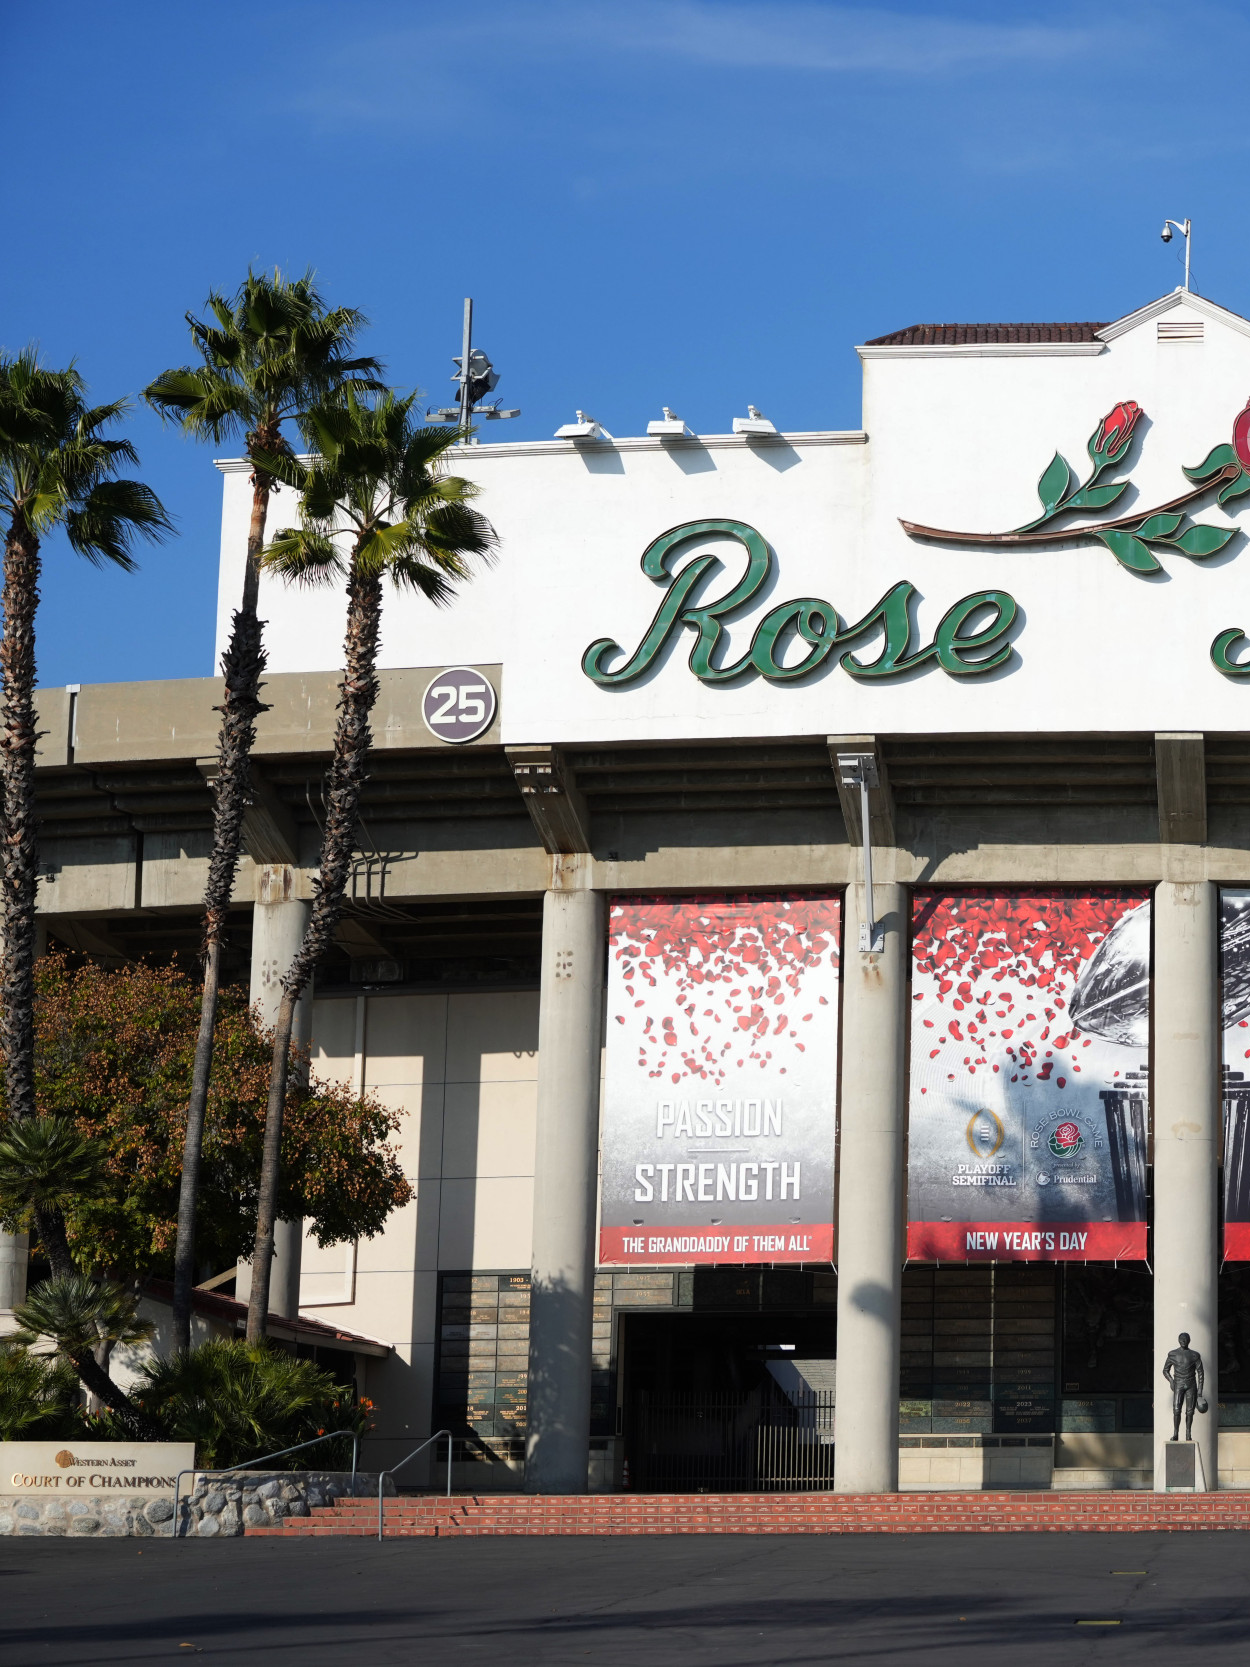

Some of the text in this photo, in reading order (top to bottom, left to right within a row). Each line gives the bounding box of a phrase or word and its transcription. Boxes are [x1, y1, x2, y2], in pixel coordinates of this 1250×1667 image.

[581, 518, 1017, 685] Rose
[430, 685, 486, 724] 25
[656, 1098, 782, 1138] PASSION
[1031, 1108, 1102, 1148] ROSE BOWL GAME
[958, 1164, 1011, 1174] PLAYOFF
[634, 1162, 801, 1202] STRENGTH
[952, 1176, 1016, 1186] SEMIFINAL
[1054, 1174, 1097, 1183] Prudential
[623, 1237, 645, 1253] THE
[648, 1236, 730, 1253] GRANDDADDY
[733, 1236, 749, 1252] OF
[753, 1236, 785, 1252] THEM
[966, 1232, 1088, 1250] NEW YEAR'S DAY
[68, 1457, 137, 1467] WESTERN ASSET
[11, 1472, 178, 1489] COURT OF CHAMPIONS
